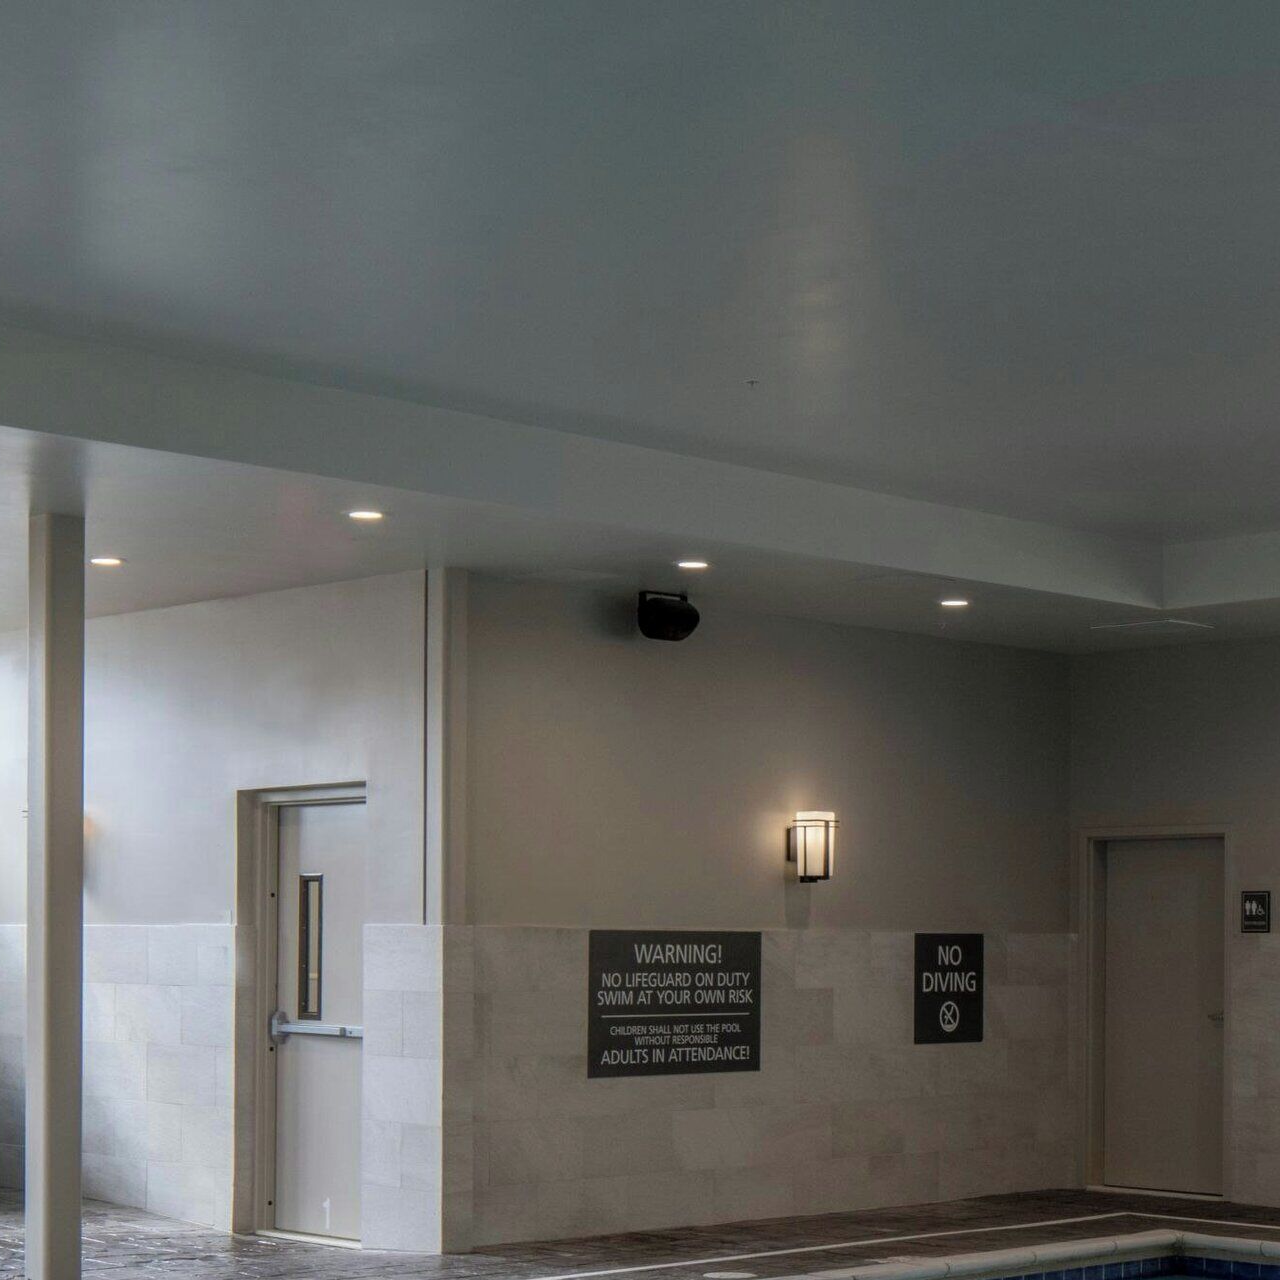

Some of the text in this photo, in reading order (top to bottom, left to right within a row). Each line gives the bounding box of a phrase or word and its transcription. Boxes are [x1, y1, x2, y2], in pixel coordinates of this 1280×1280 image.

[634, 943, 722, 964] WARNING!
[938, 945, 962, 966] NO
[601, 972, 751, 988] NO LIFEGUARD ON DUTY
[922, 971, 976, 992] DIVING
[597, 989, 753, 1006] SWIM AT YOUR OWN RISK
[609, 1023, 742, 1036] CHILDREN SHALL NOT USE THE POOL
[634, 1034, 718, 1046] WITHOUT RESPONSIBLE
[600, 1046, 750, 1065] ADULTS IN ATTENDANCE!
